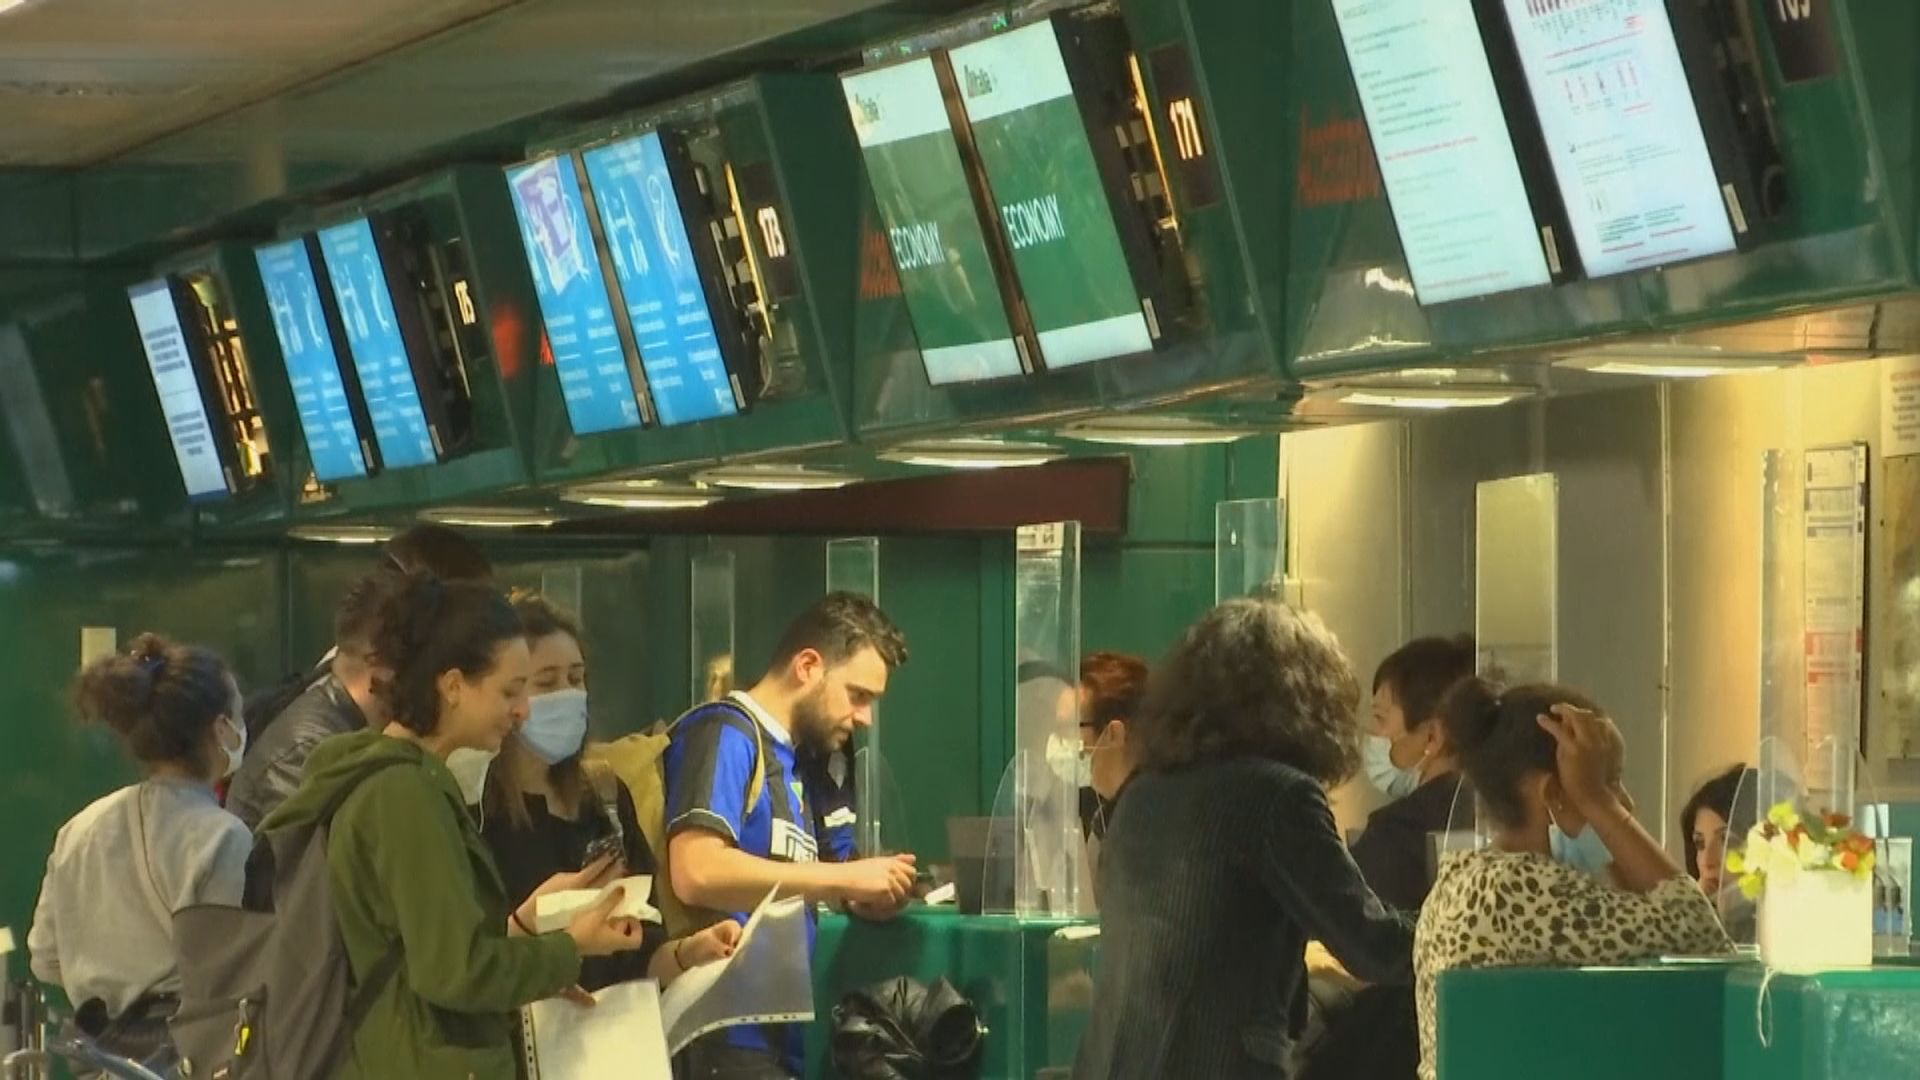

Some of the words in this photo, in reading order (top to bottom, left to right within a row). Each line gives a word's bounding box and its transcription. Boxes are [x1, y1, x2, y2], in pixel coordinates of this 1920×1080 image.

[1169, 97, 1203, 160] 171
[889, 220, 946, 271] ECONOMY
[1001, 192, 1066, 250] ECONOMY
